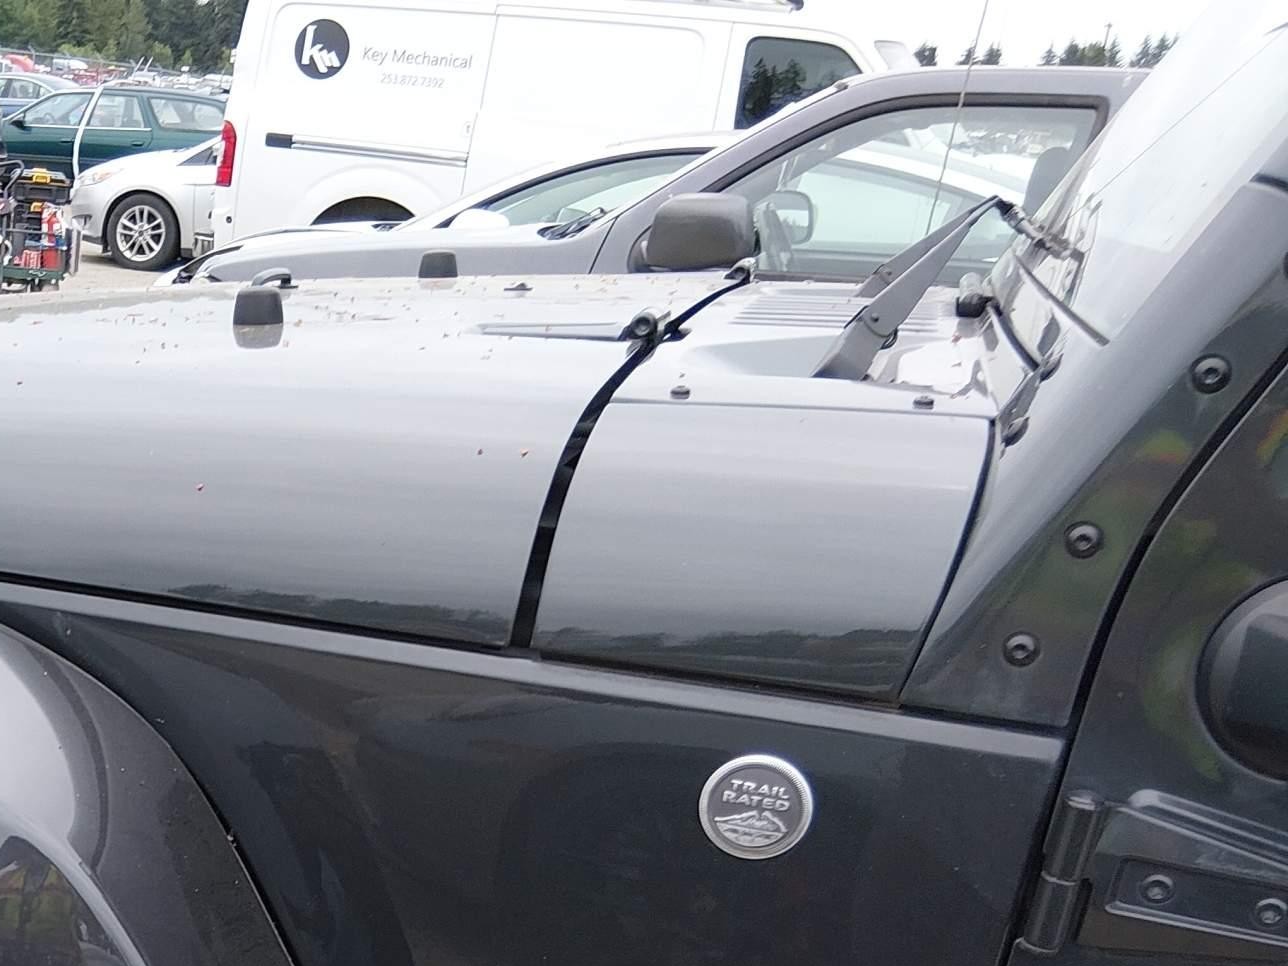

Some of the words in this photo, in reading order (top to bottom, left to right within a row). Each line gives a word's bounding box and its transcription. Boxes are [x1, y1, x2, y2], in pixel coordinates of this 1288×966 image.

[362, 47, 389, 66] Key
[392, 49, 473, 70] Mechanical
[730, 779, 789, 799] TRAIL
[722, 790, 791, 811] RATED
